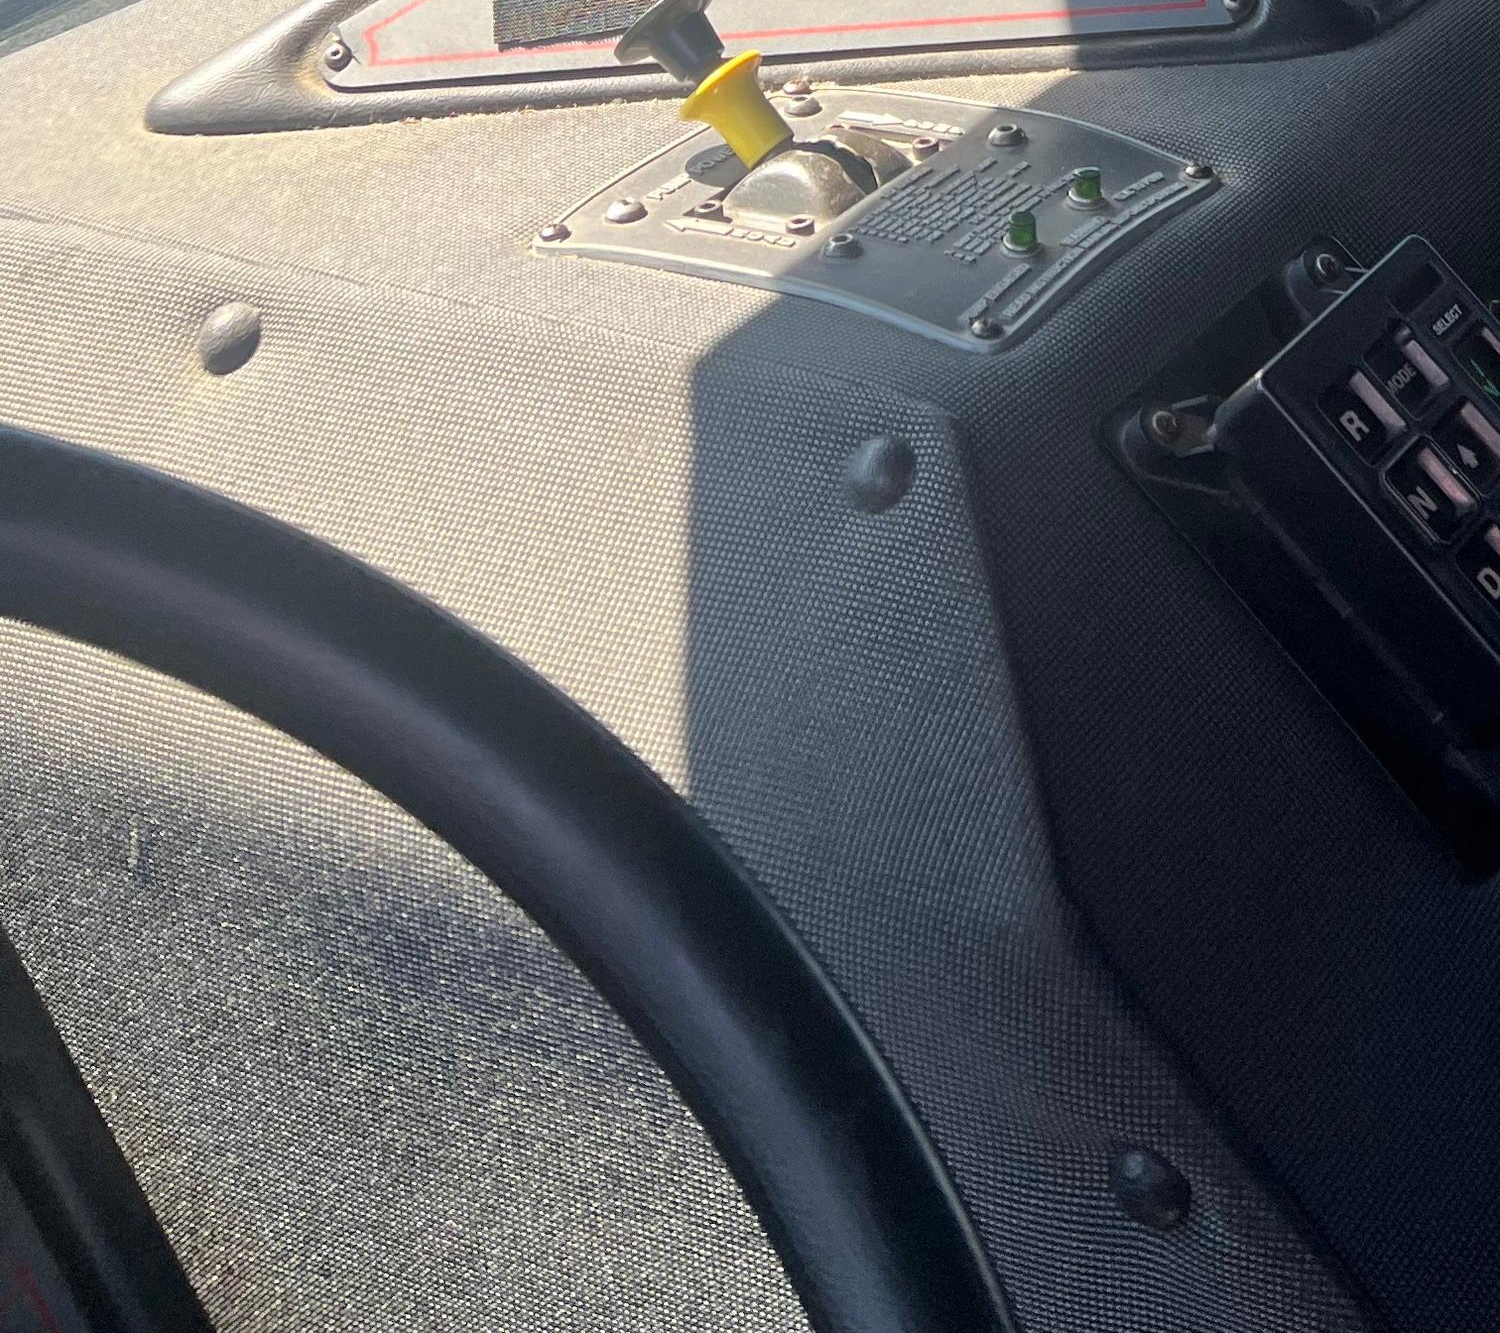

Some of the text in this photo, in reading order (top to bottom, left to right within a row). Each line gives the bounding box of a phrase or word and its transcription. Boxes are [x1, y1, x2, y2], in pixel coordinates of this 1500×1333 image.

[1431, 303, 1463, 336] SELECT
[1339, 409, 1370, 442] R
[1407, 485, 1438, 519] N
